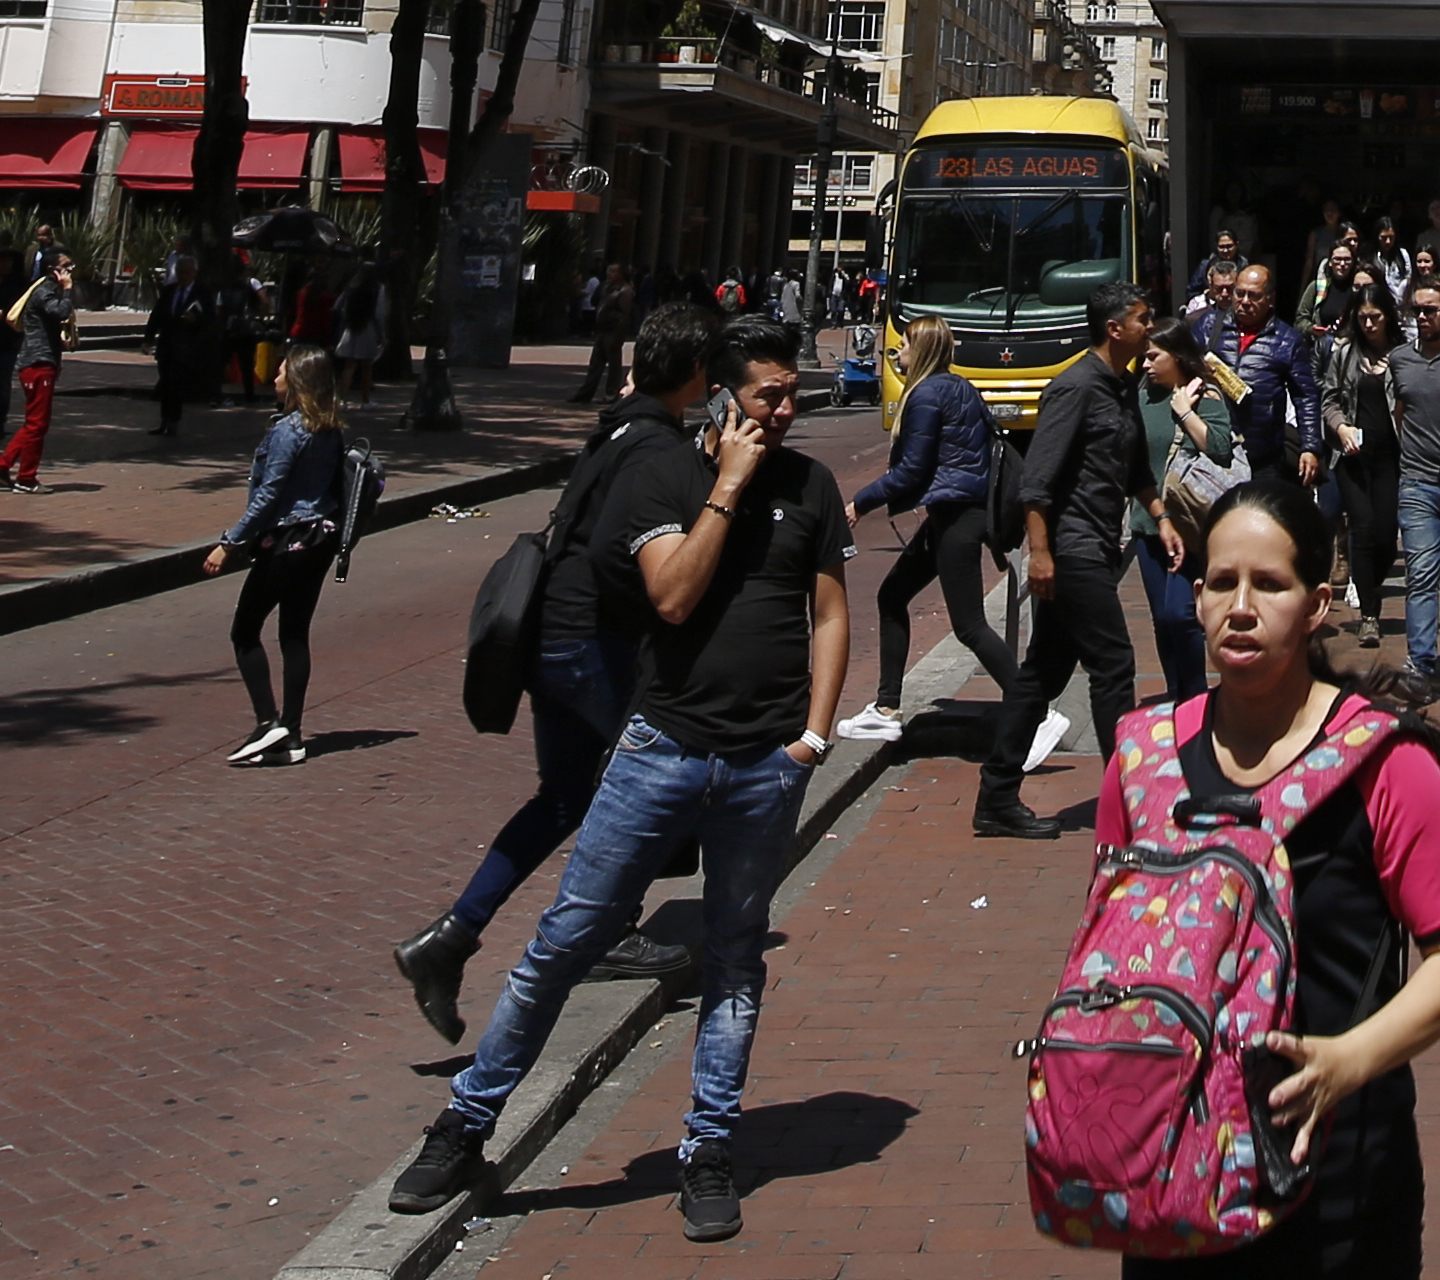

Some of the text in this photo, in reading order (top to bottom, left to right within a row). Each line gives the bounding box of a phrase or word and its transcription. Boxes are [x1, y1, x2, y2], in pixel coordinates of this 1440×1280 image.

[136, 88, 206, 108] ROMAN
[935, 157, 1099, 177] J23 LAS AGUAS
